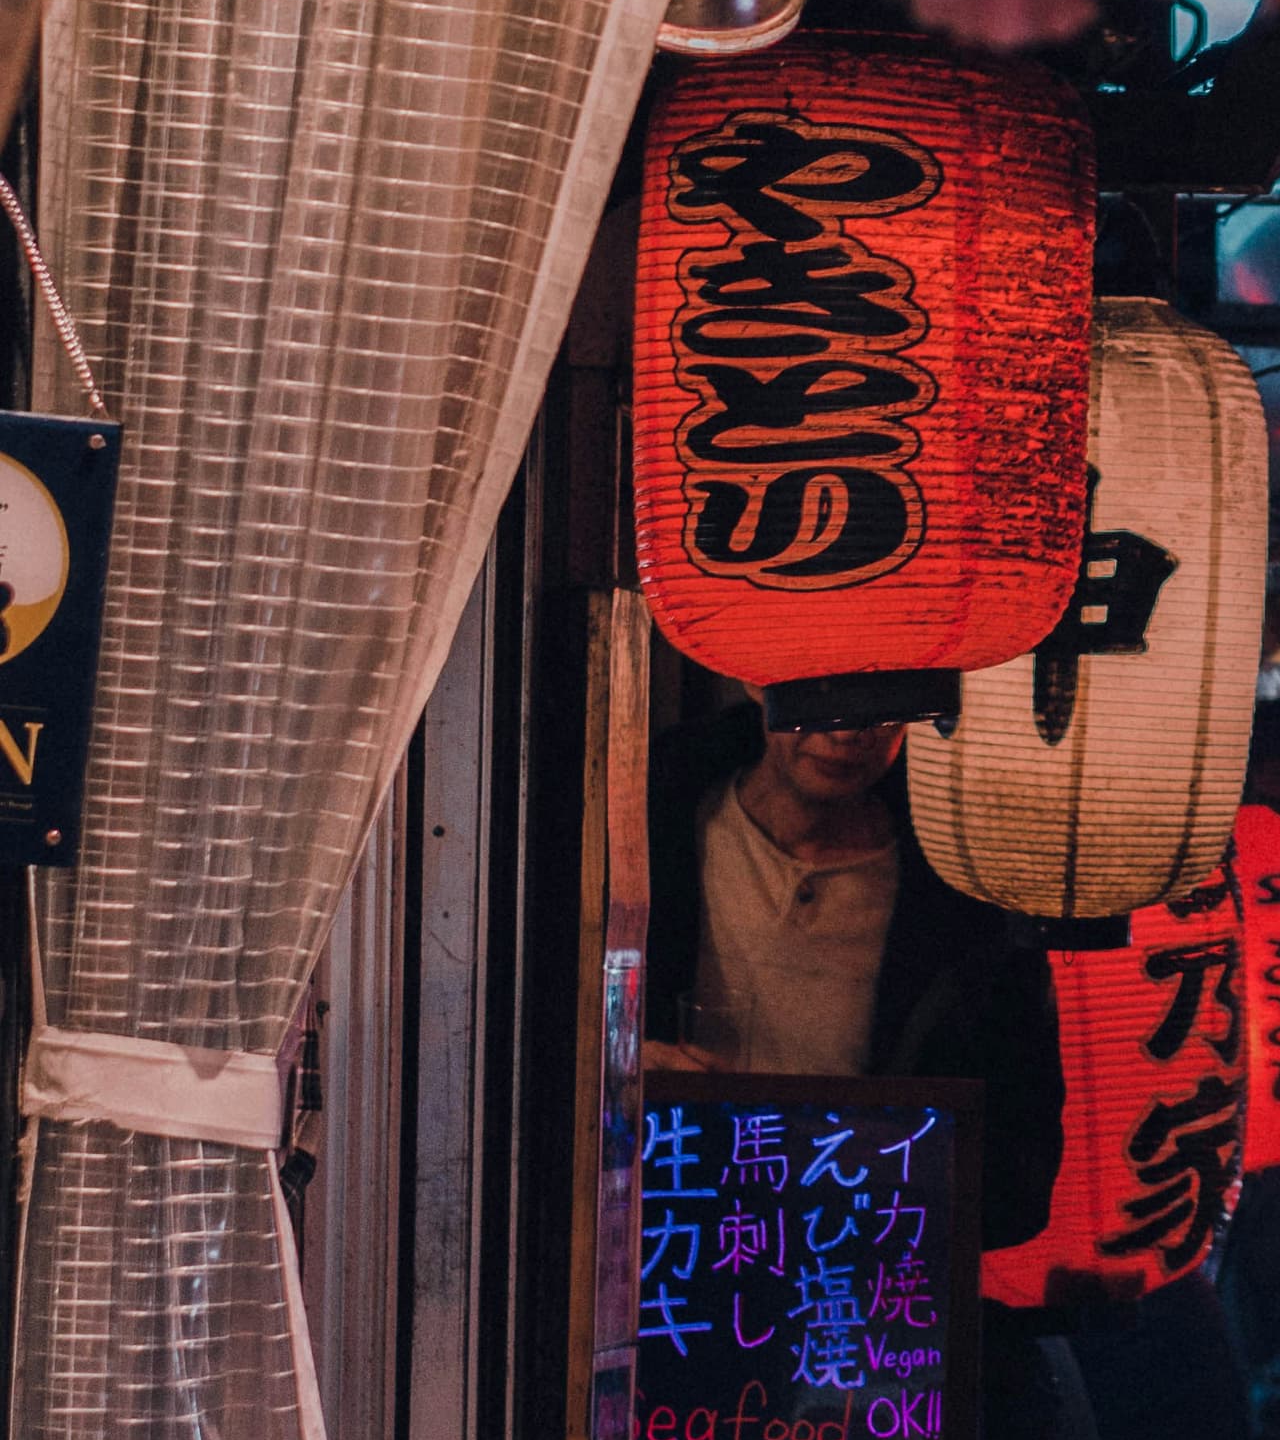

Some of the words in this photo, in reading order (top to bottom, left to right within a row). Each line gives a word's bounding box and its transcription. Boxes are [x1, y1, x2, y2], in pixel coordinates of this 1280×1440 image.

[638, 1107, 718, 1358] 生カキ
[711, 1112, 790, 1349] 馬刺し
[864, 1333, 941, 1379] Vegan
